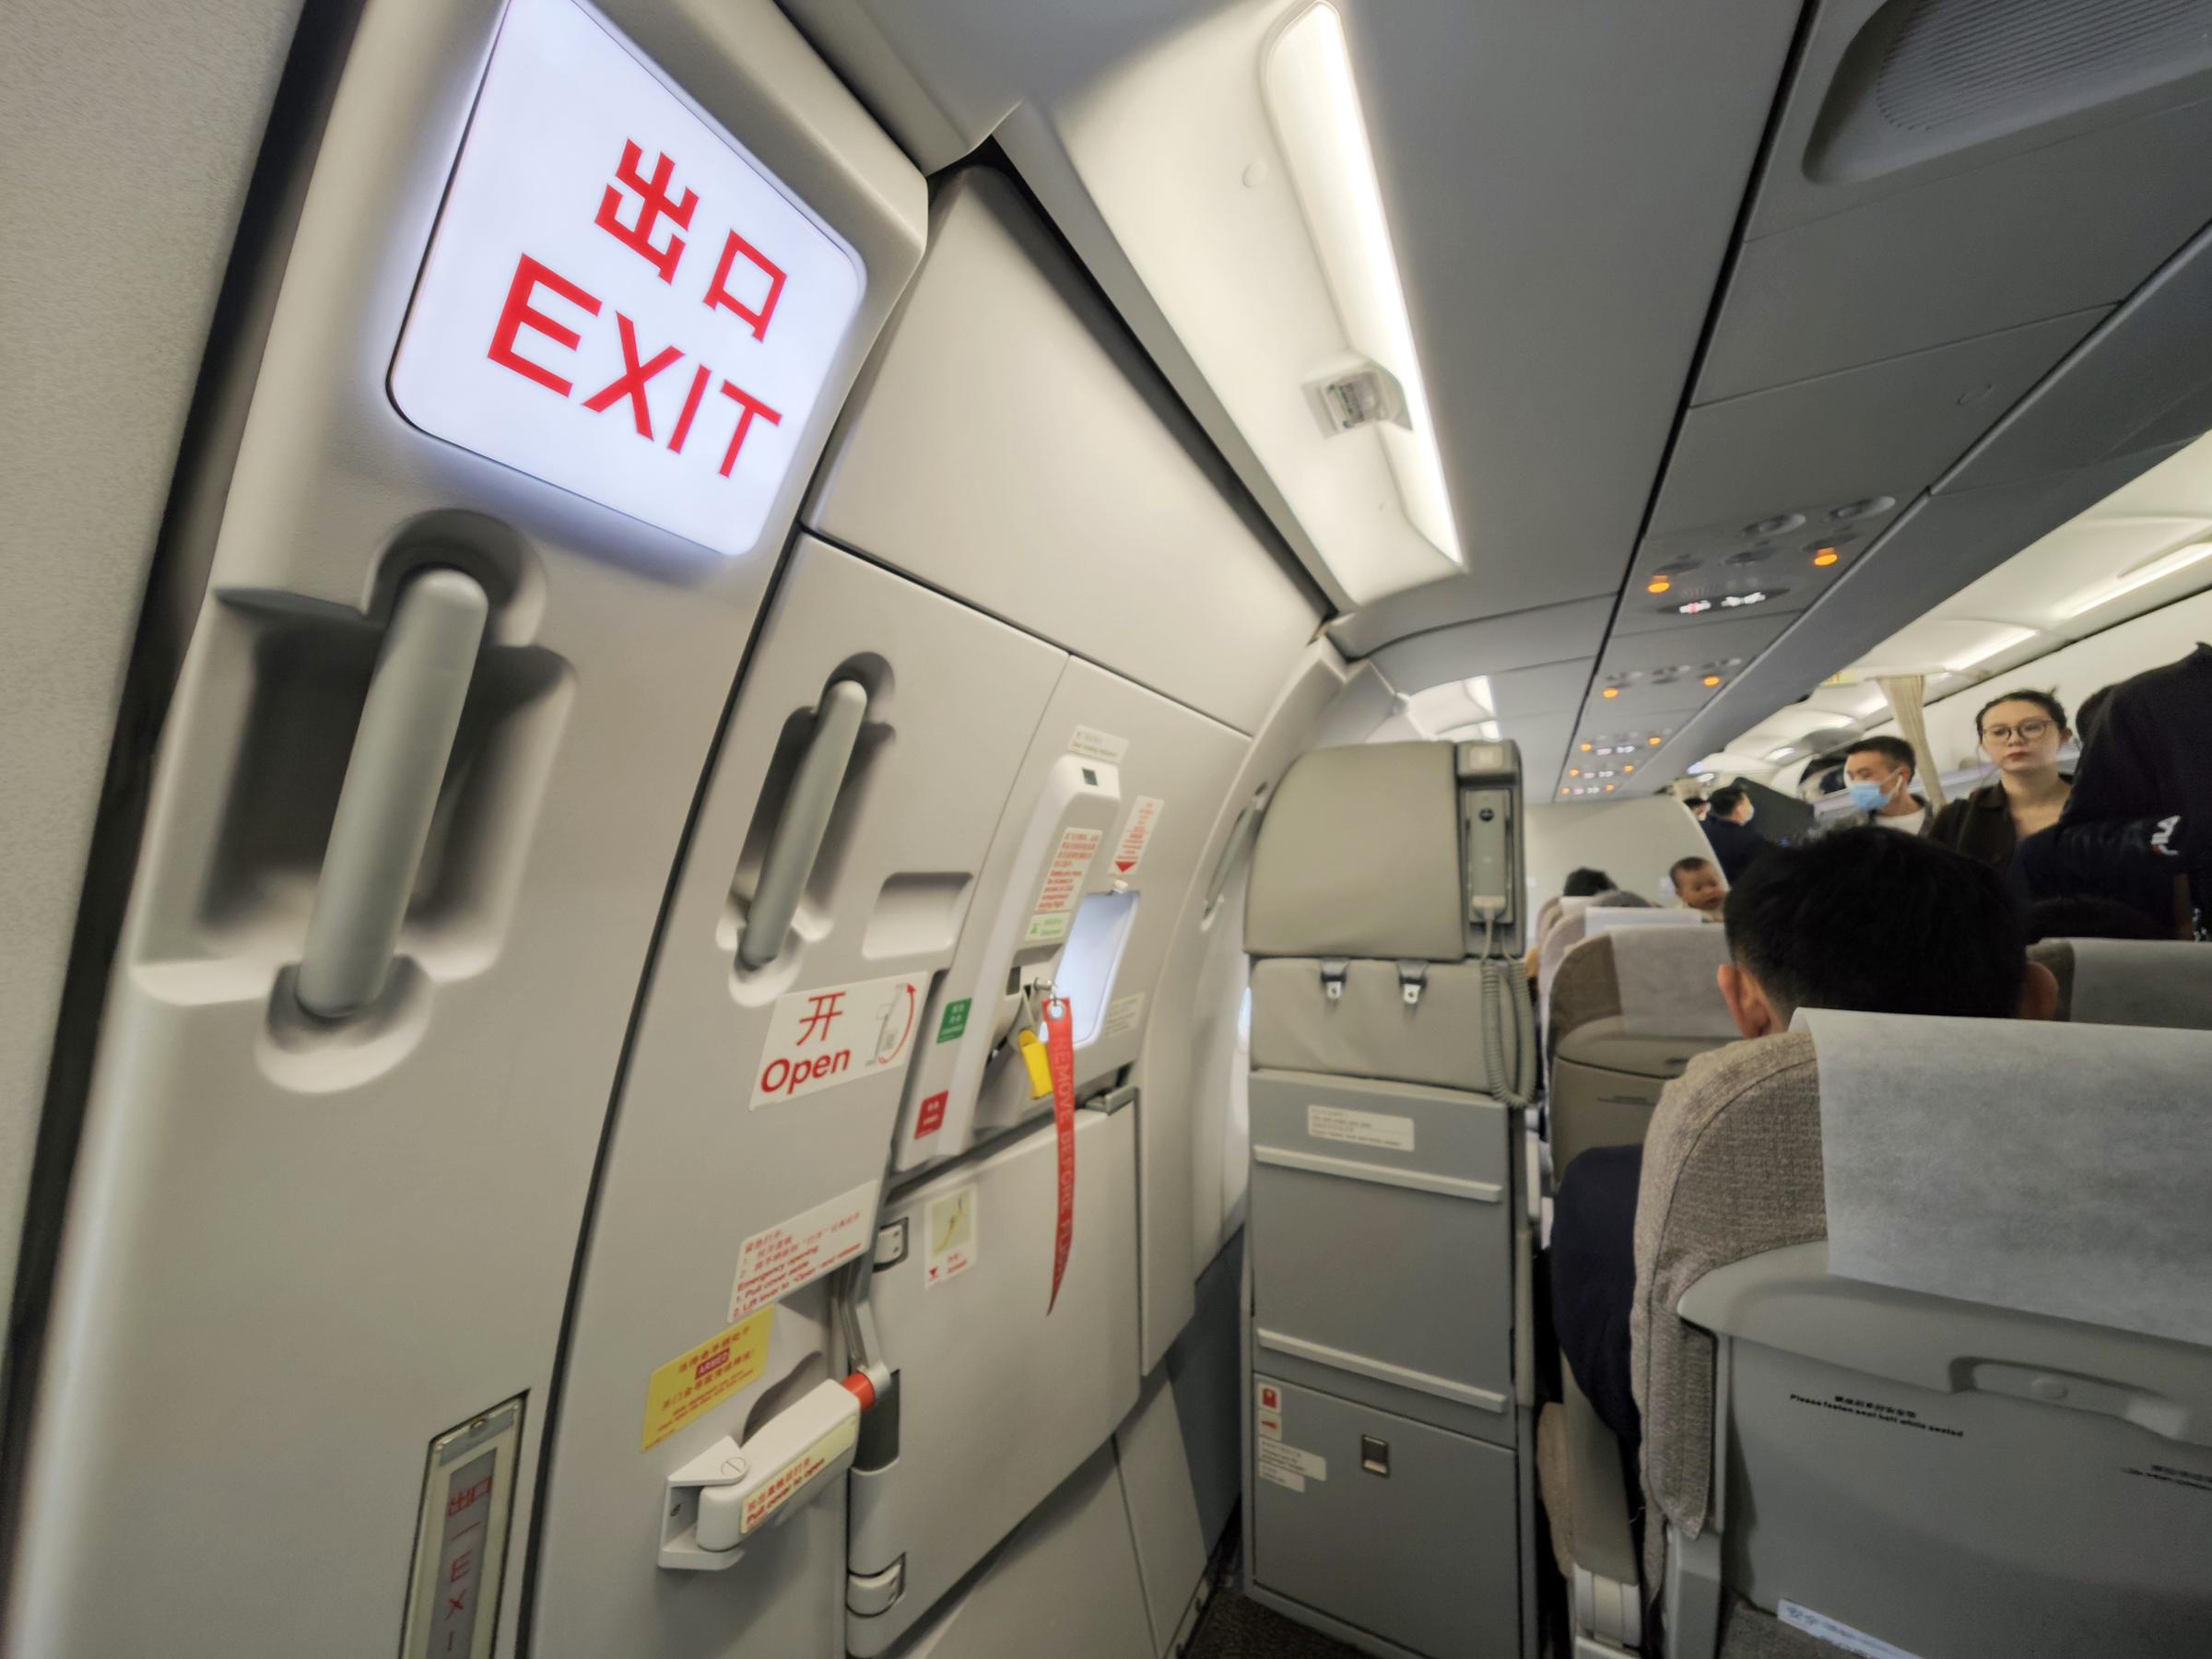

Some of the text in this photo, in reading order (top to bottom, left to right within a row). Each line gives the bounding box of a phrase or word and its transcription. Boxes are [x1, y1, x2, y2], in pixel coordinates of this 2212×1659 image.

[594, 138, 788, 344] 出口
[488, 252, 783, 478] EXIT
[796, 992, 846, 1047] 开
[760, 1048, 852, 1095] Open
[1053, 1038, 1073, 1123] REMOVE
[698, 1350, 729, 1375] ARMED
[1790, 1394, 1822, 1406] Please
[447, 1475, 493, 1518] 出口
[746, 1504, 766, 1526] Pull
[444, 1550, 473, 1653] EXI
